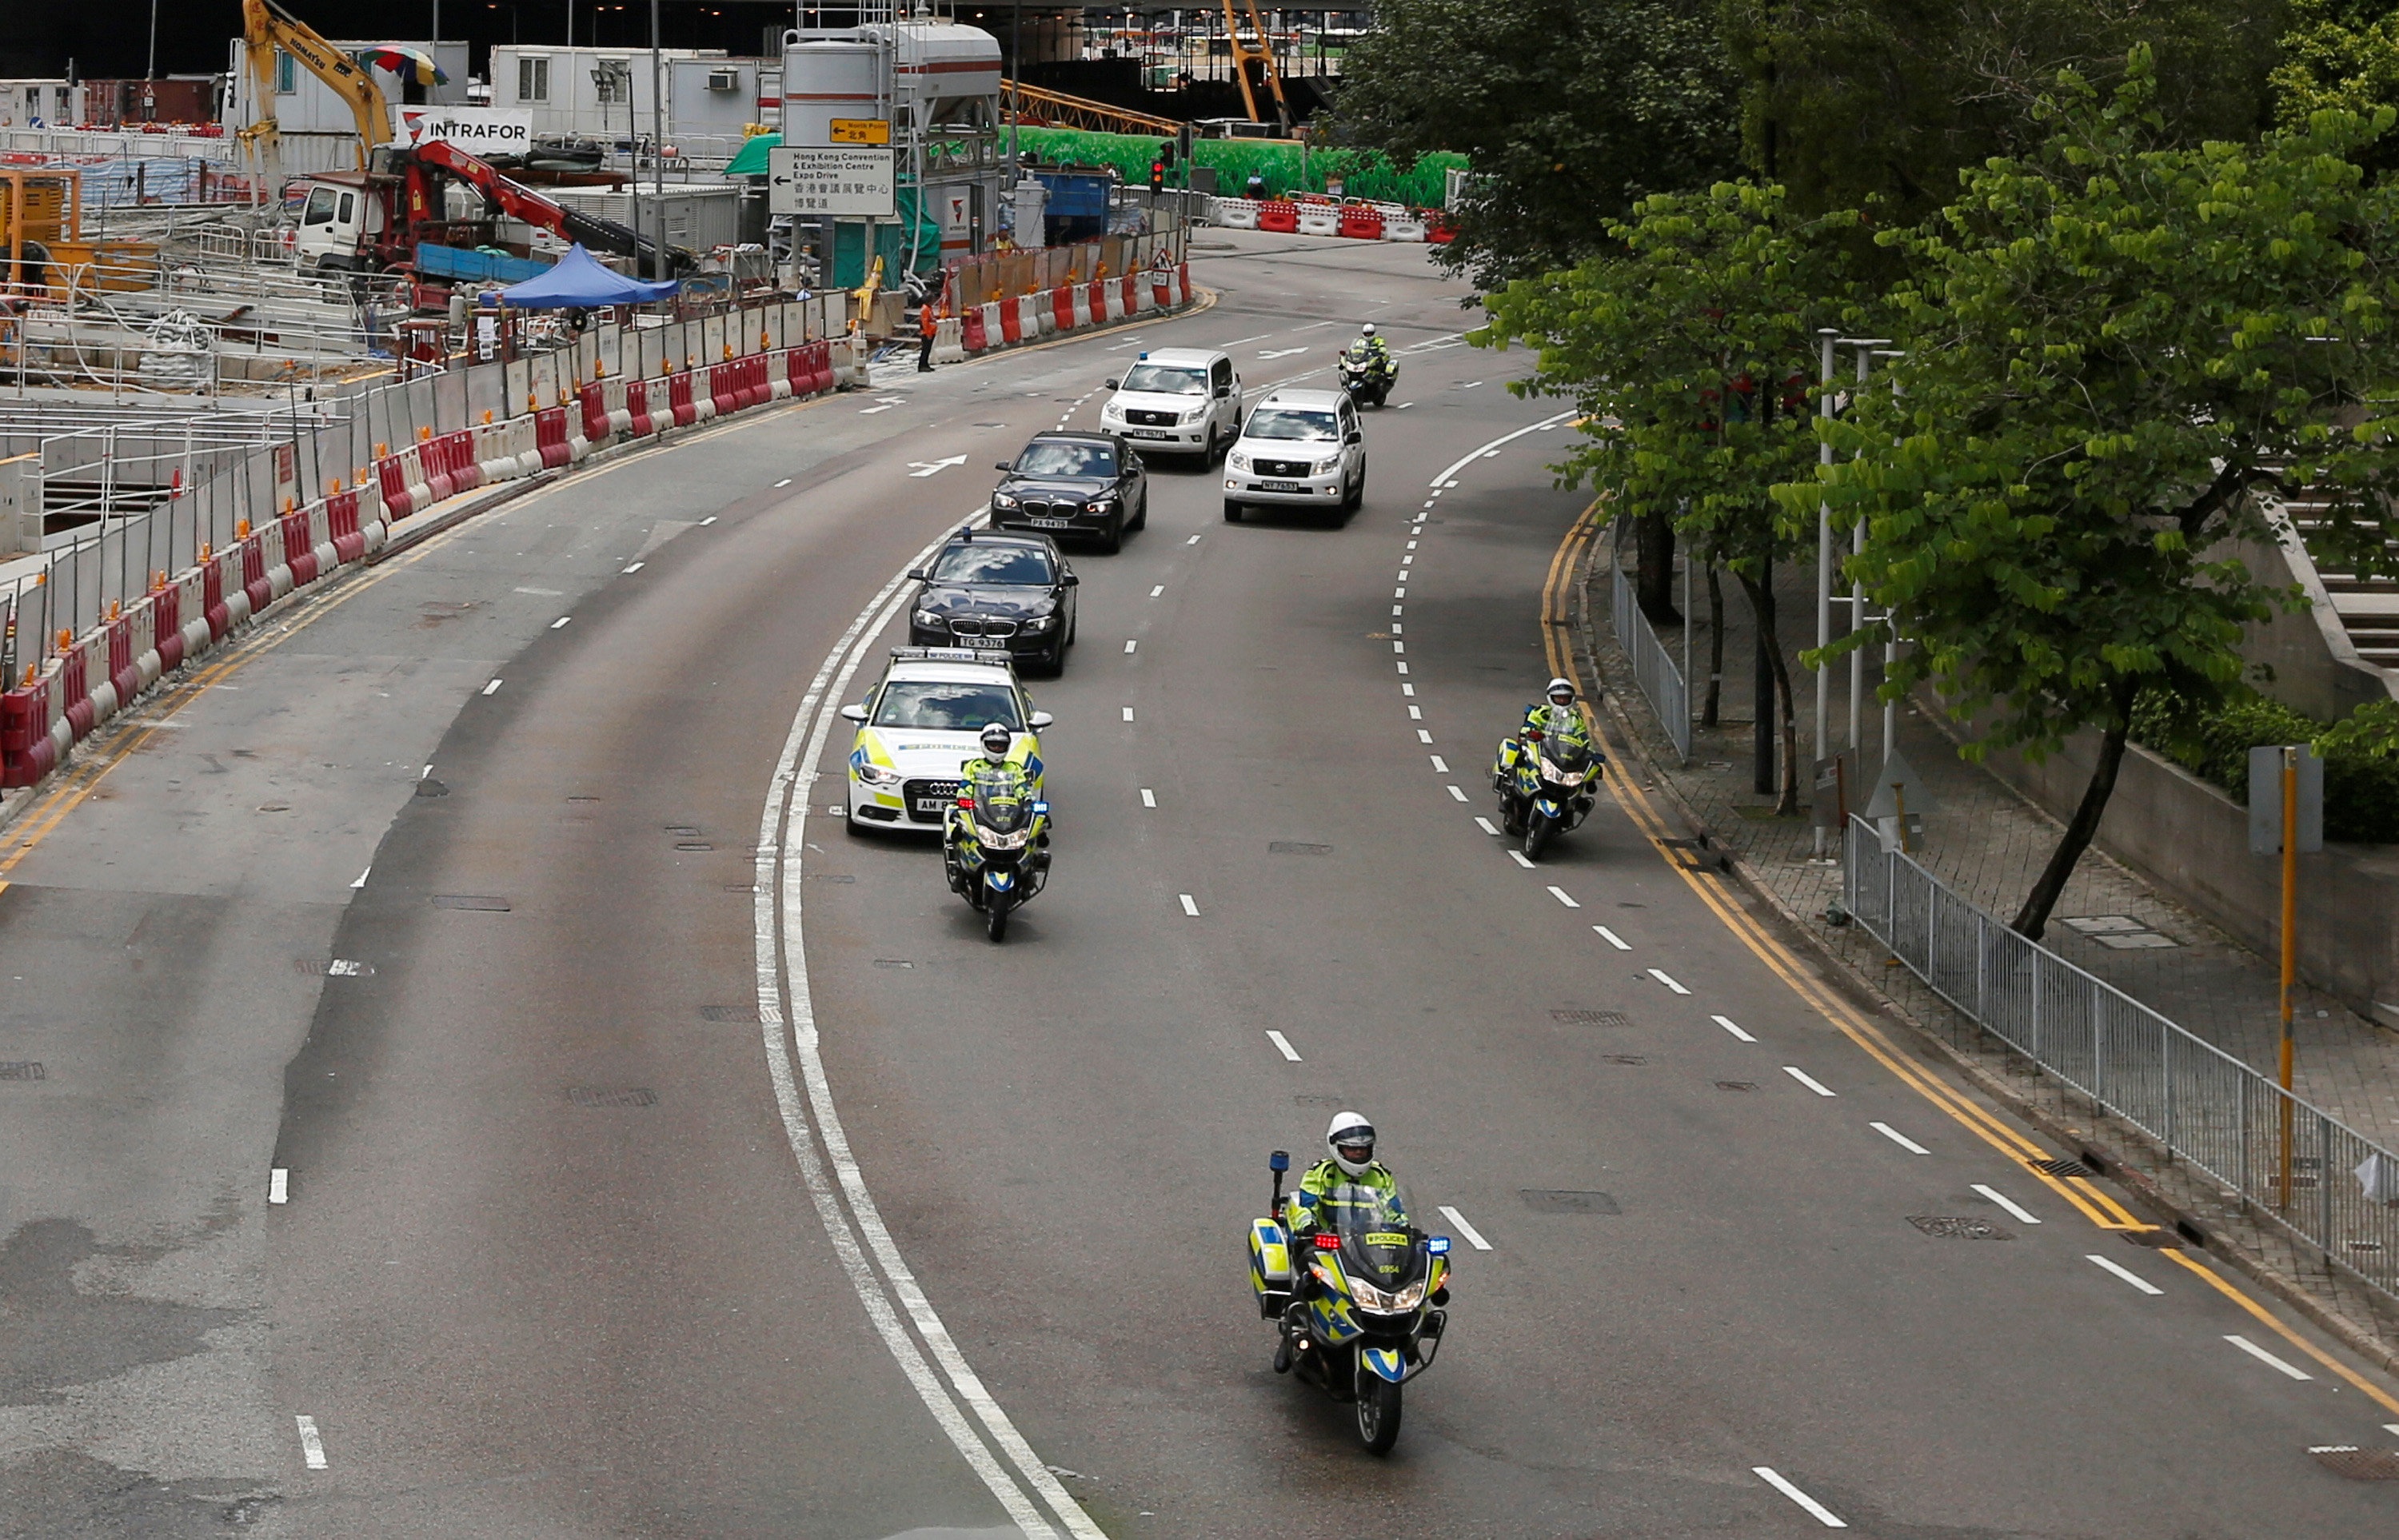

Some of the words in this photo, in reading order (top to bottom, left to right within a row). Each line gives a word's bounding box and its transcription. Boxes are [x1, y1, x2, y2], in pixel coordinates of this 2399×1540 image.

[289, 38, 326, 70] KOMATSU
[430, 122, 525, 139] INTRAFOR
[848, 130, 867, 140] 北角
[793, 153, 816, 162] Hong
[817, 153, 840, 162] Kong
[841, 153, 890, 162] Convention
[794, 183, 888, 194] 香港會議展覽中心
[794, 197, 828, 209] 博覽道
[979, 639, 1004, 648] 9376
[921, 800, 936, 809] AM
